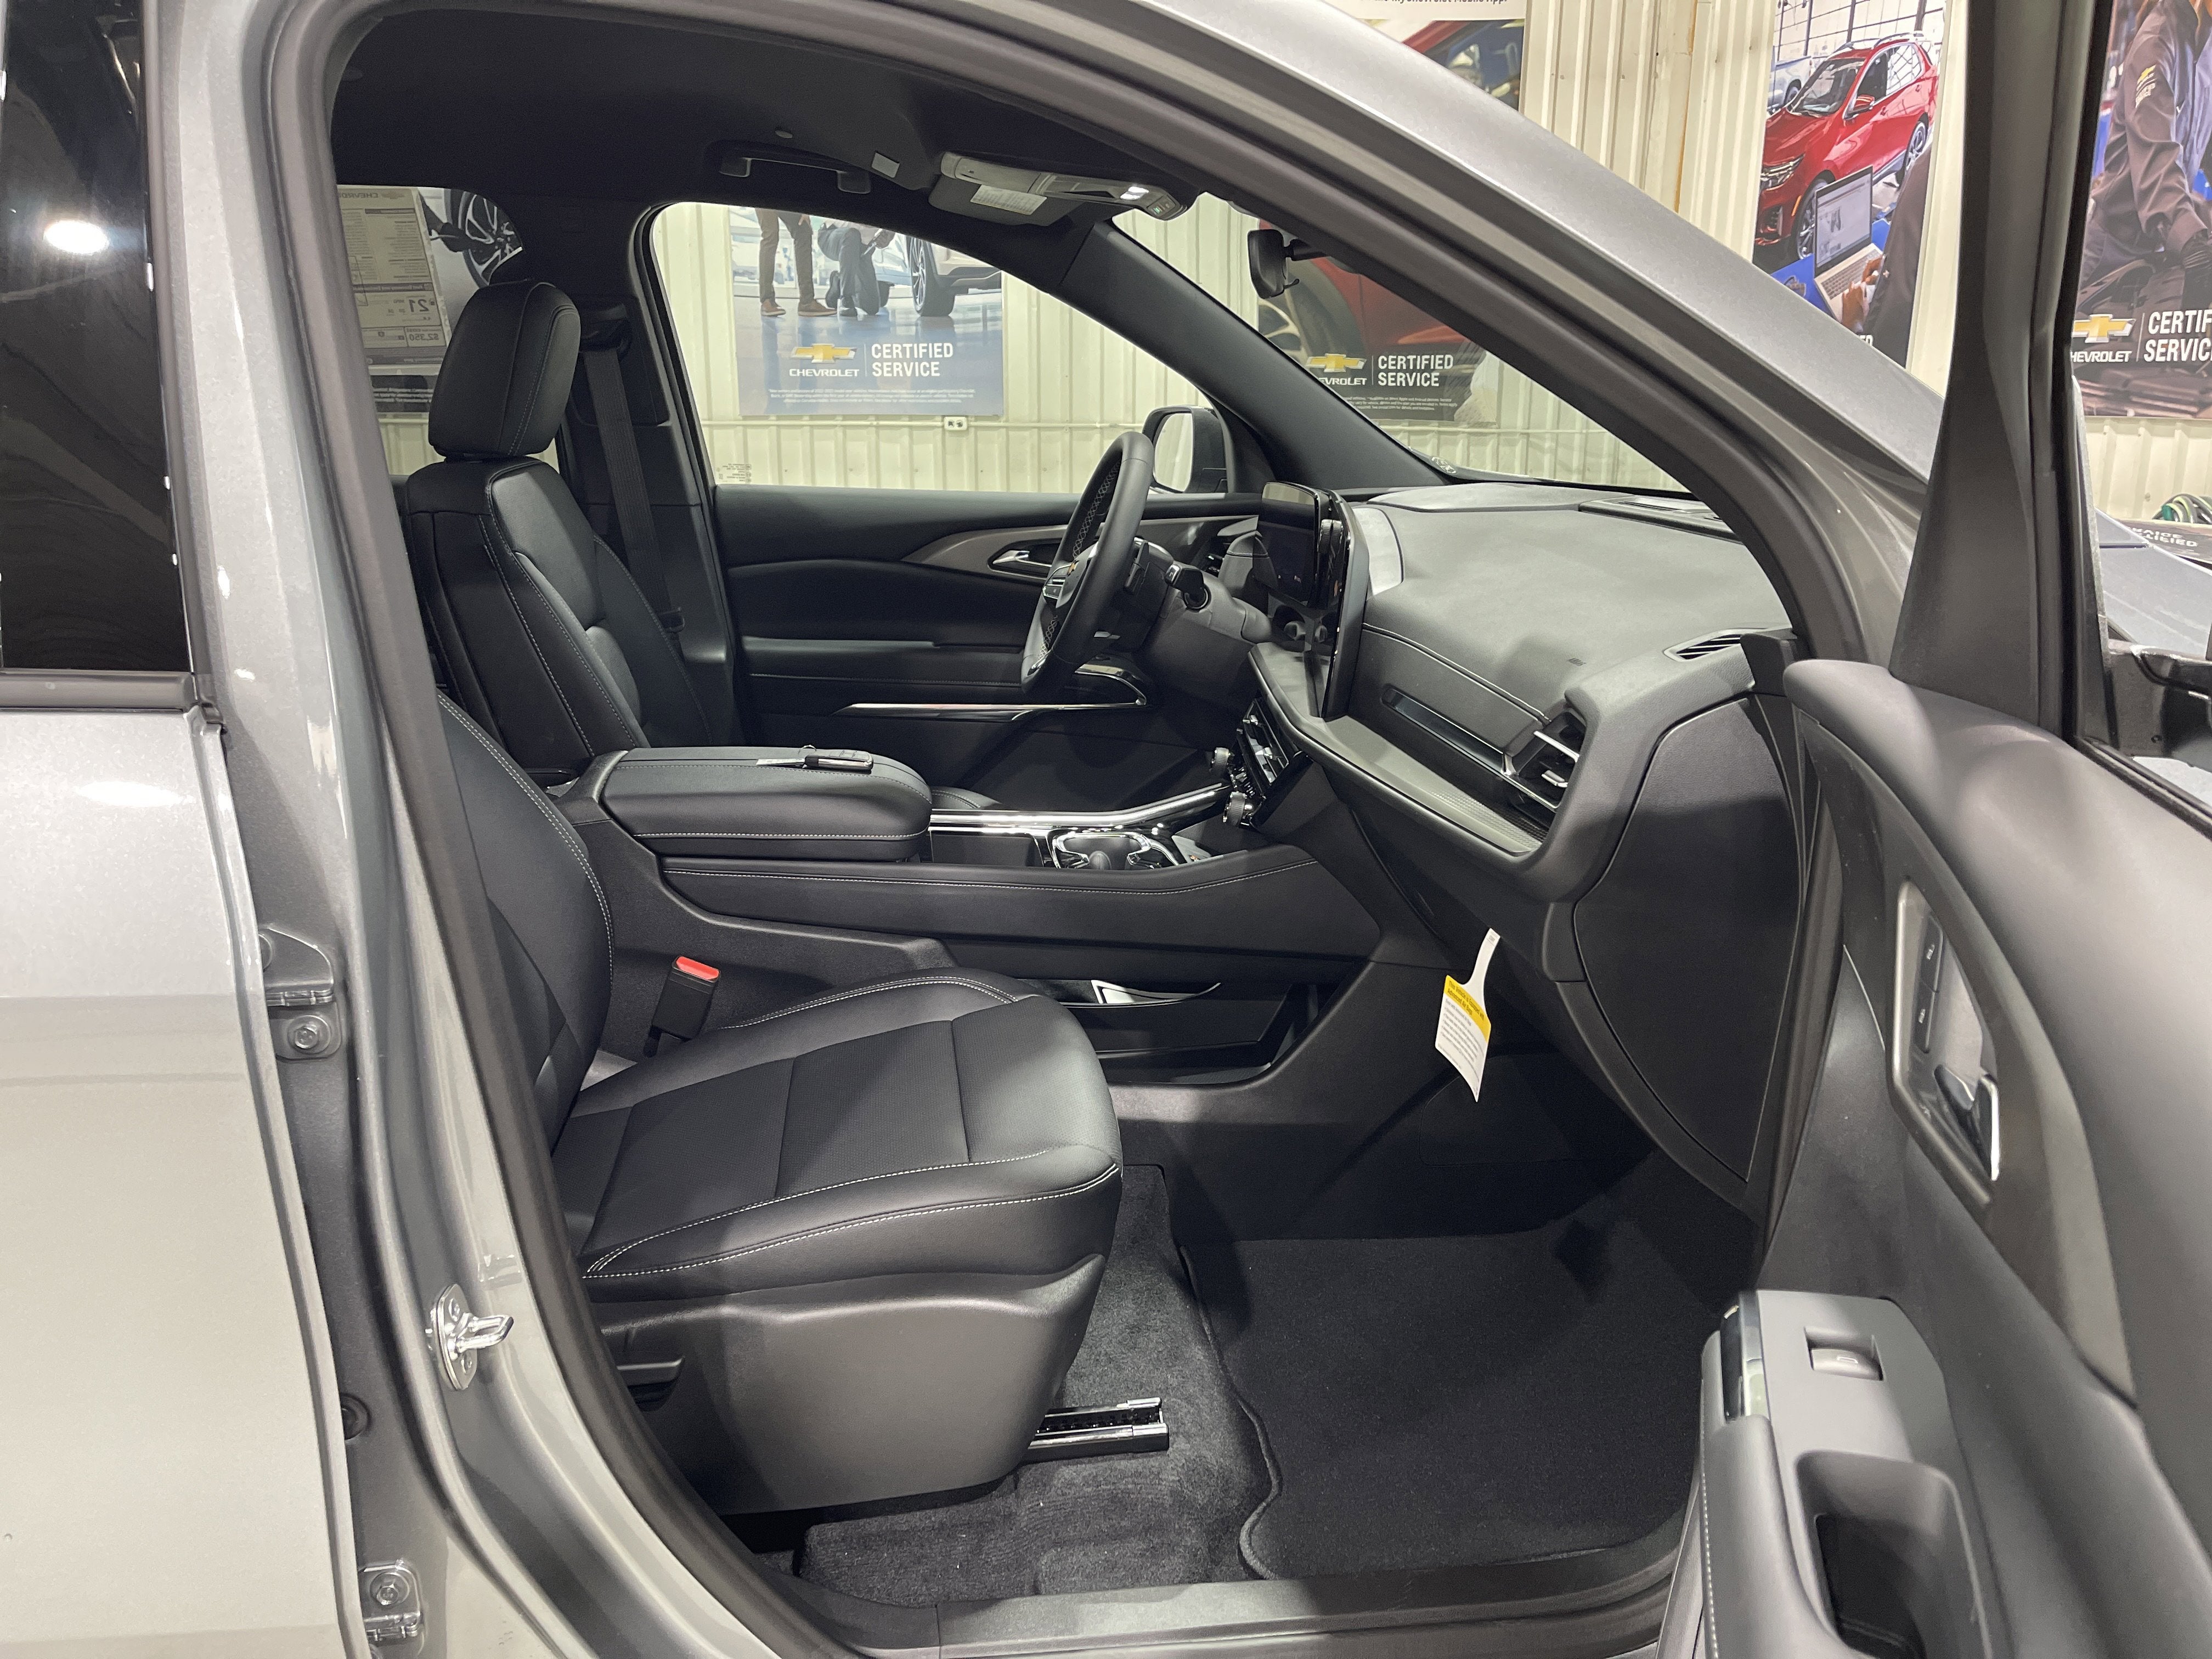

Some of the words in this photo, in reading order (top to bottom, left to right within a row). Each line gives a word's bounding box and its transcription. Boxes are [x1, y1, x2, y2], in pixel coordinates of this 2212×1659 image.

[2148, 309, 2212, 335] CERTIF
[871, 343, 953, 359] CERTIFIED
[2070, 351, 2132, 363] HEVROLET
[2143, 337, 2212, 362] SERVIC
[872, 362, 941, 377] SERVICE
[1378, 354, 1454, 370] CERTIFIED
[789, 369, 860, 377] CHEVROLET
[1378, 372, 1440, 387] SERVICE
[1318, 377, 1368, 386] EVROLET
